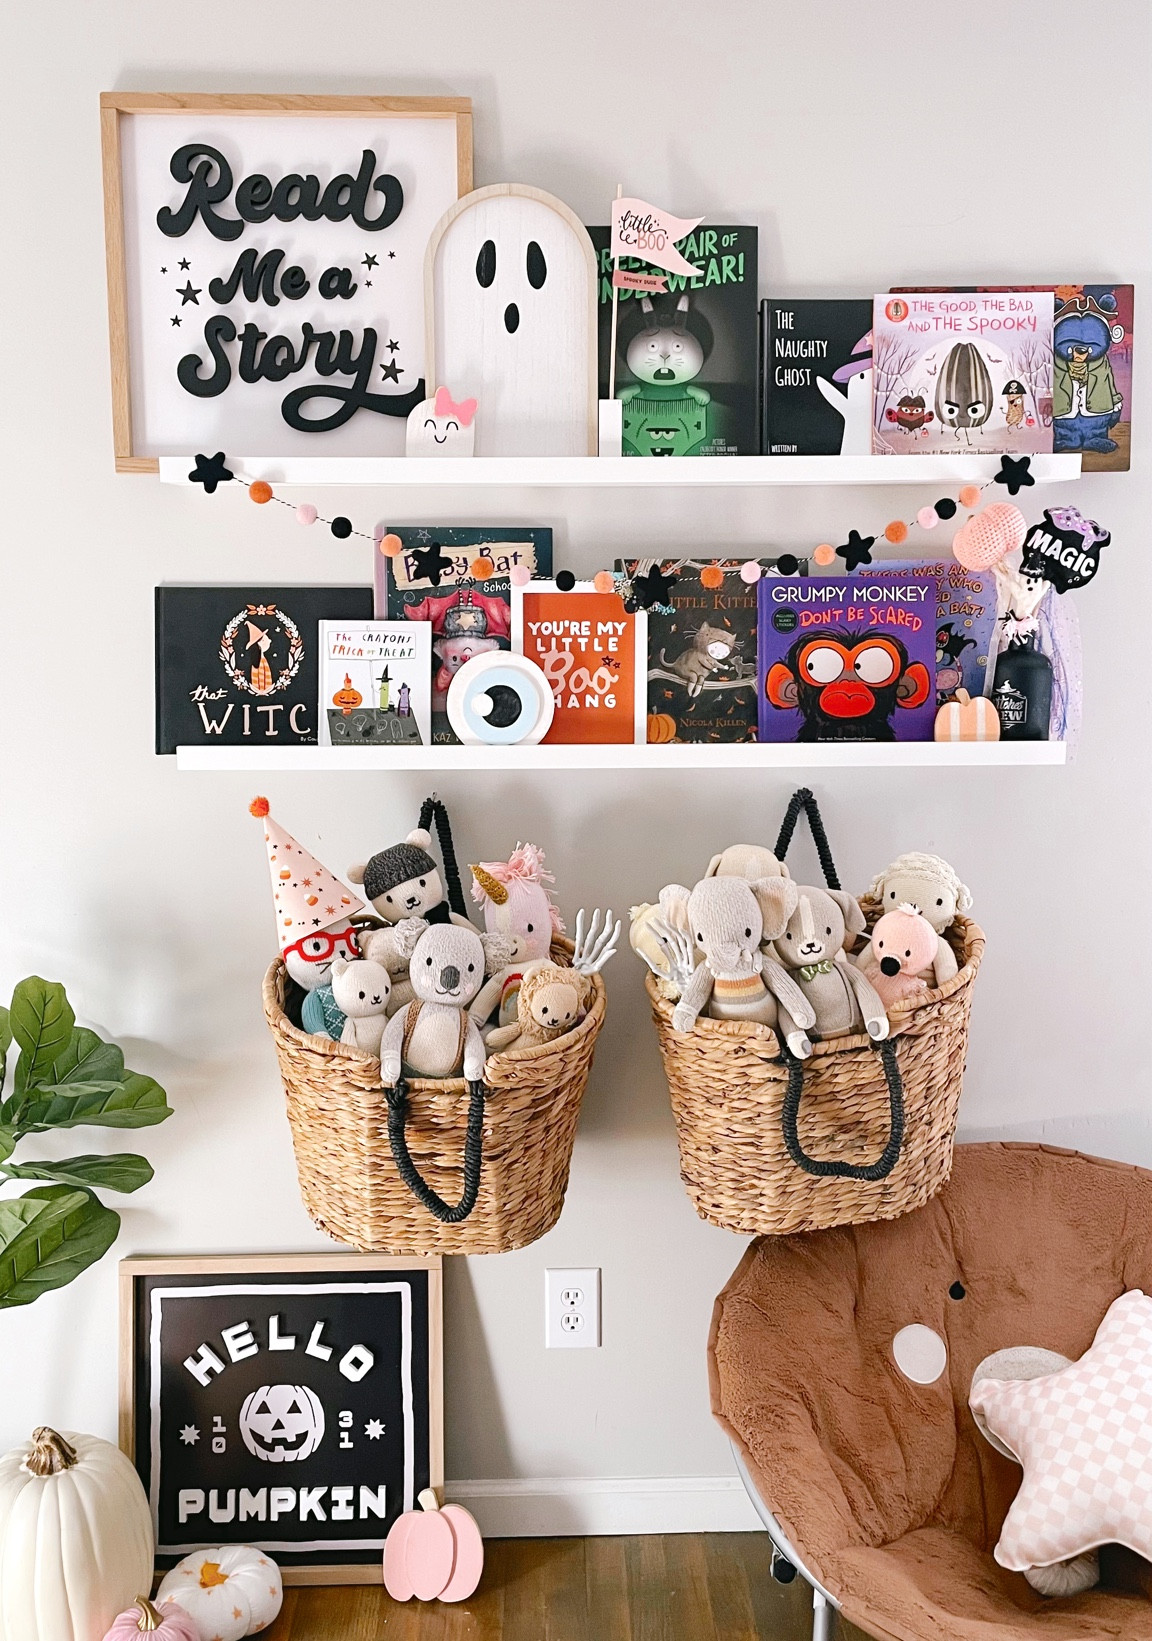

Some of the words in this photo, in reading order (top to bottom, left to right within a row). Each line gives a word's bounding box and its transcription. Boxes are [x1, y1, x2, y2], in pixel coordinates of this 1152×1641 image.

[156, 144, 404, 241] Read
[621, 210, 667, 234] little
[637, 229, 665, 251] BOO
[722, 233, 738, 248] OF
[209, 248, 310, 306] Me
[318, 266, 358, 300] a
[912, 300, 934, 312] THE
[939, 300, 978, 315] GOOD,
[982, 300, 1005, 312] THE
[1009, 298, 1034, 313] BAD,
[775, 310, 794, 330] THE
[907, 321, 931, 333] AND
[932, 316, 962, 332] THE
[967, 315, 1037, 335] SPOOKY
[775, 338, 828, 358] NAUGHTY
[177, 315, 426, 432] Story
[775, 366, 811, 387] GHOST
[1026, 528, 1095, 577] MAGIC
[912, 563, 944, 577] WAS
[771, 586, 847, 602] GRUMPY
[853, 586, 929, 602] MONKEY
[948, 577, 983, 593] WHO
[670, 597, 707, 609] ITTLE
[713, 594, 758, 610] KITTE
[950, 601, 985, 619] BAT!
[527, 620, 591, 636] YOU'RE
[597, 621, 627, 636] MY
[799, 607, 844, 627] DON'T
[847, 606, 865, 622] BE
[869, 605, 922, 631] SCARED
[336, 633, 352, 642] The
[362, 633, 412, 645] CRAYONS
[536, 637, 619, 652] LITTLE
[332, 644, 364, 656] TRICK
[379, 647, 414, 657] TREAT
[540, 649, 619, 695] Boo
[189, 684, 228, 702] that
[553, 693, 617, 708] HANG
[197, 702, 312, 736] WITC
[680, 717, 713, 728] NICOLA
[716, 717, 747, 728] KILLEN
[183, 1314, 374, 1387] HELLO
[178, 1484, 386, 1524] PUMPKIN
